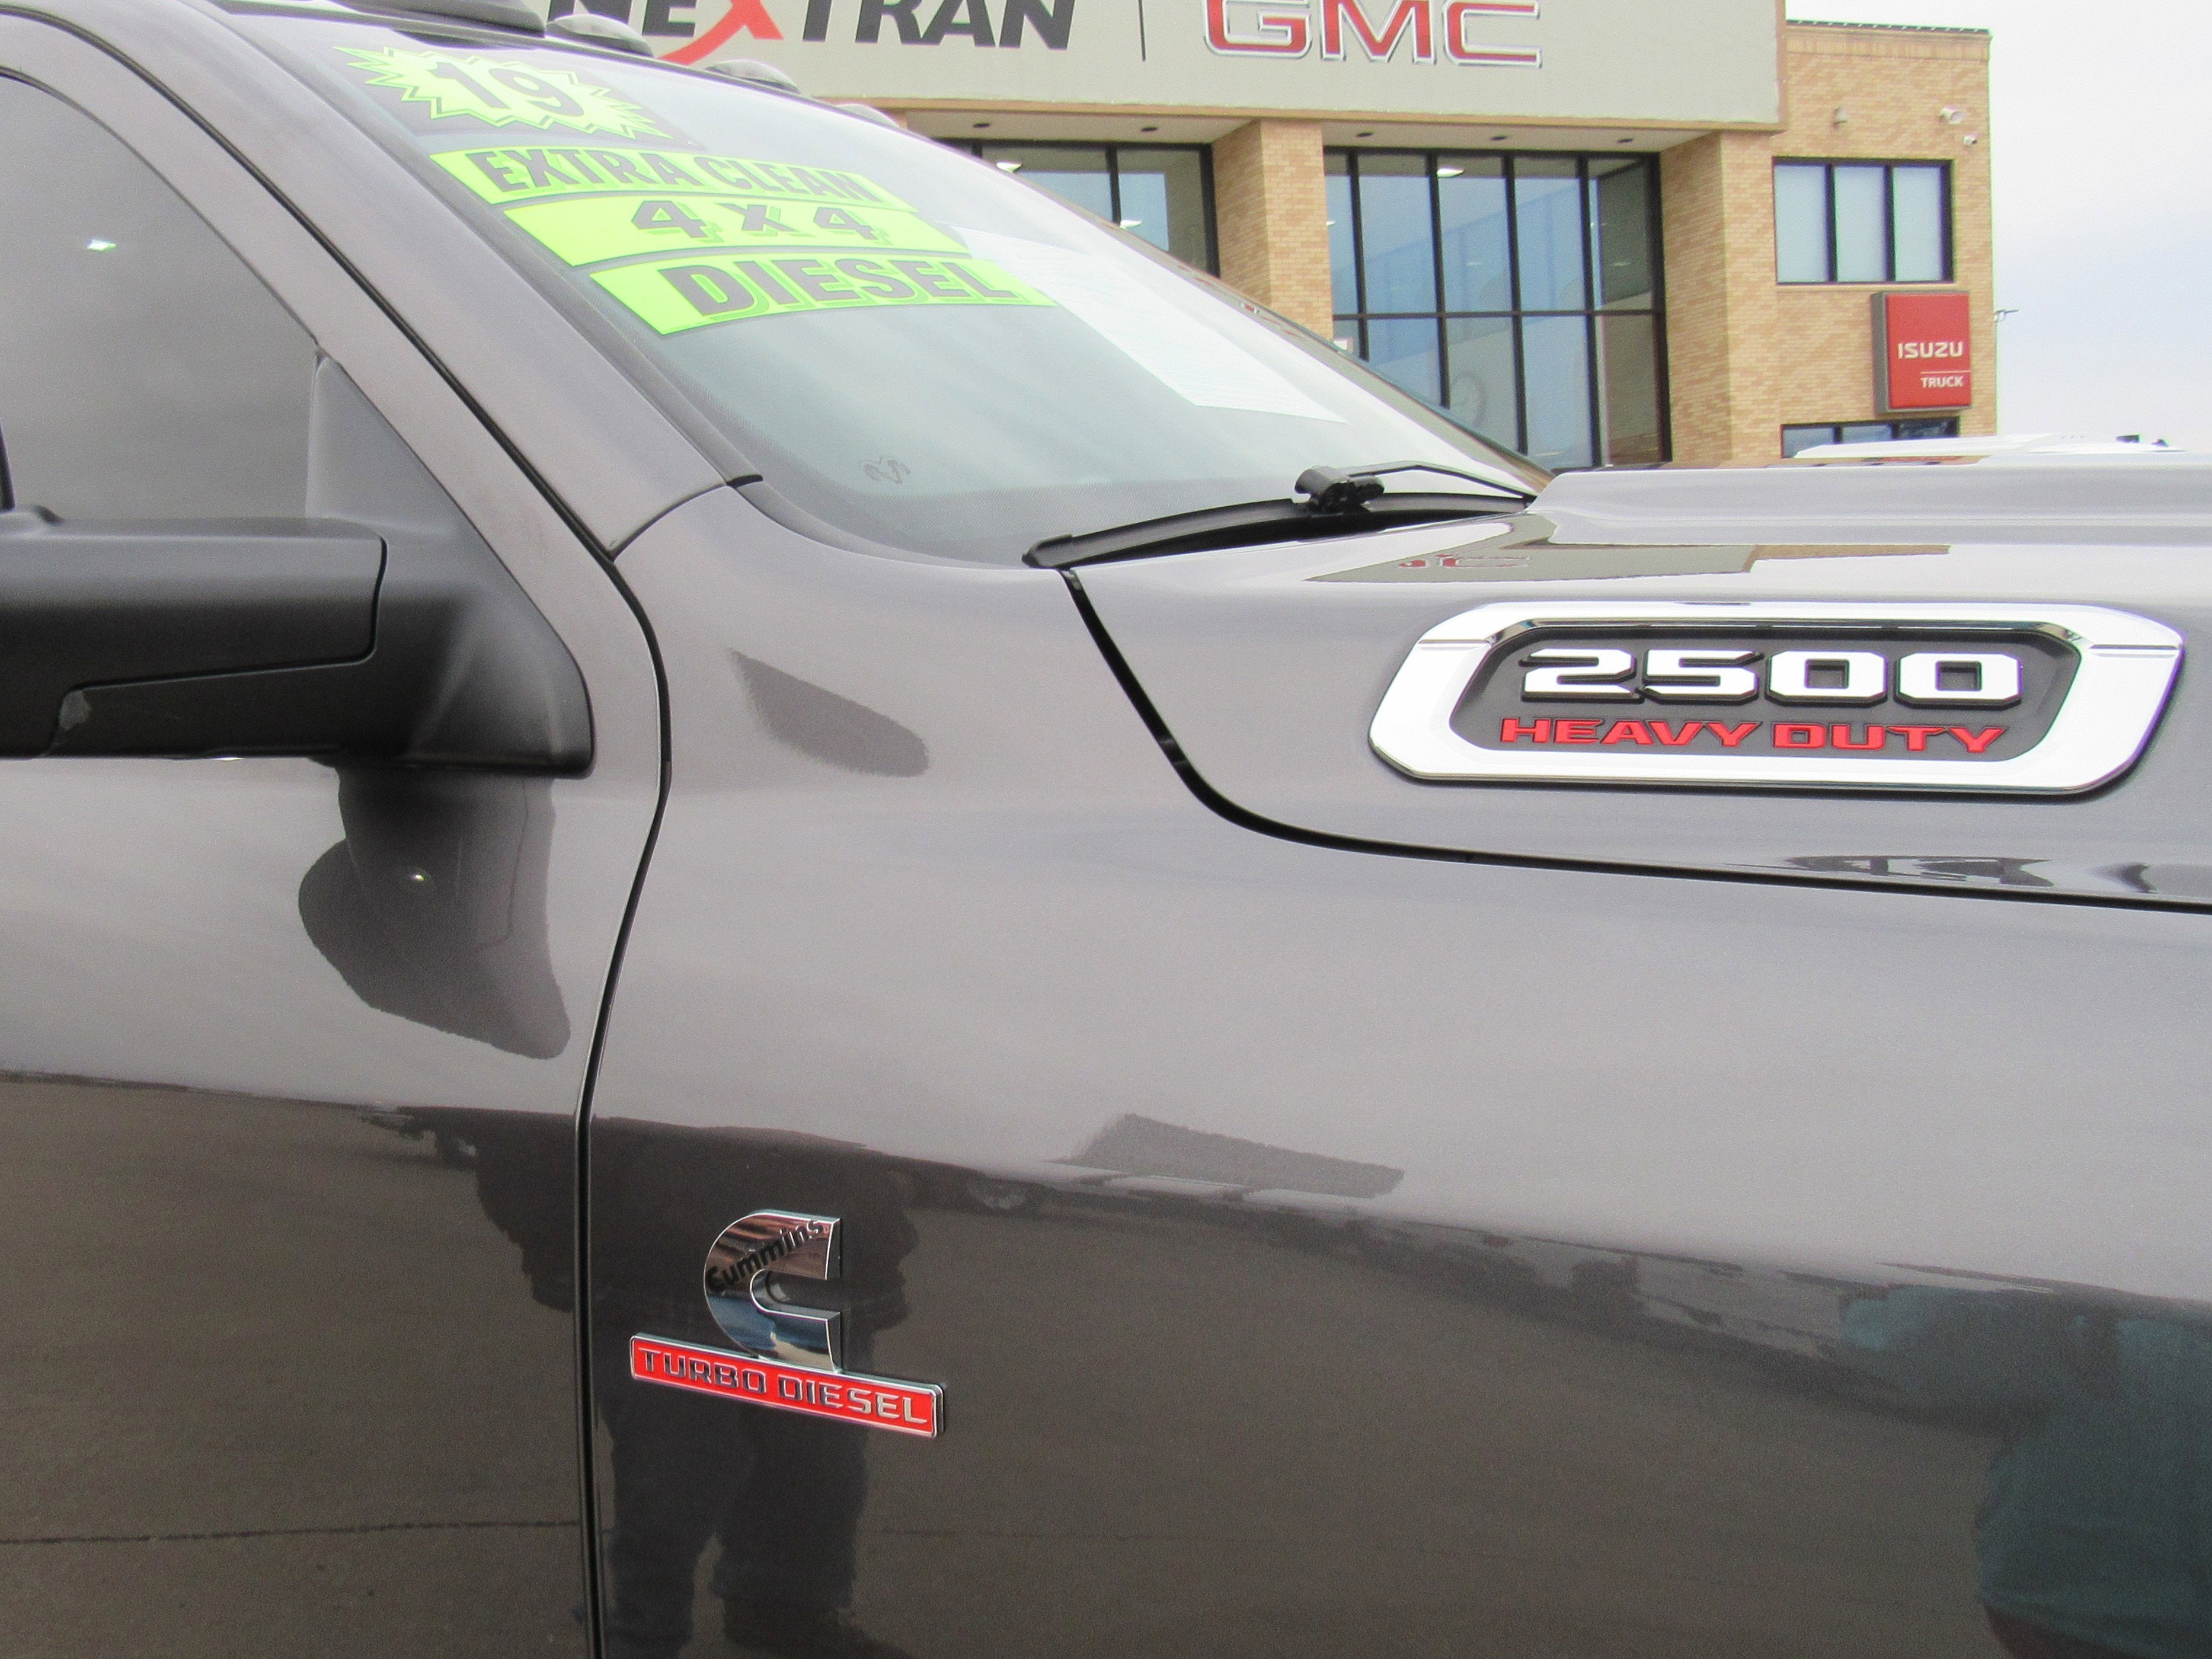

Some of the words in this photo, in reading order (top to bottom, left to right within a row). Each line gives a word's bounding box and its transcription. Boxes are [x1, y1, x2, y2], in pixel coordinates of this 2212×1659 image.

[1204, 0, 1542, 68] GMC
[427, 62, 584, 117] 19
[465, 149, 705, 192] EXTRA
[693, 156, 883, 203] CLEAN
[657, 259, 1019, 317] DIESEL
[1898, 341, 1963, 359] ISUZU
[1920, 376, 1964, 388] TRUCK
[1519, 648, 2022, 709] 2500
[1498, 718, 1762, 747] HEAVY
[1772, 724, 2006, 753] DUTY
[707, 1220, 823, 1293] Cummins
[638, 1347, 766, 1393] TURBO
[778, 1374, 928, 1424] DIESEL
